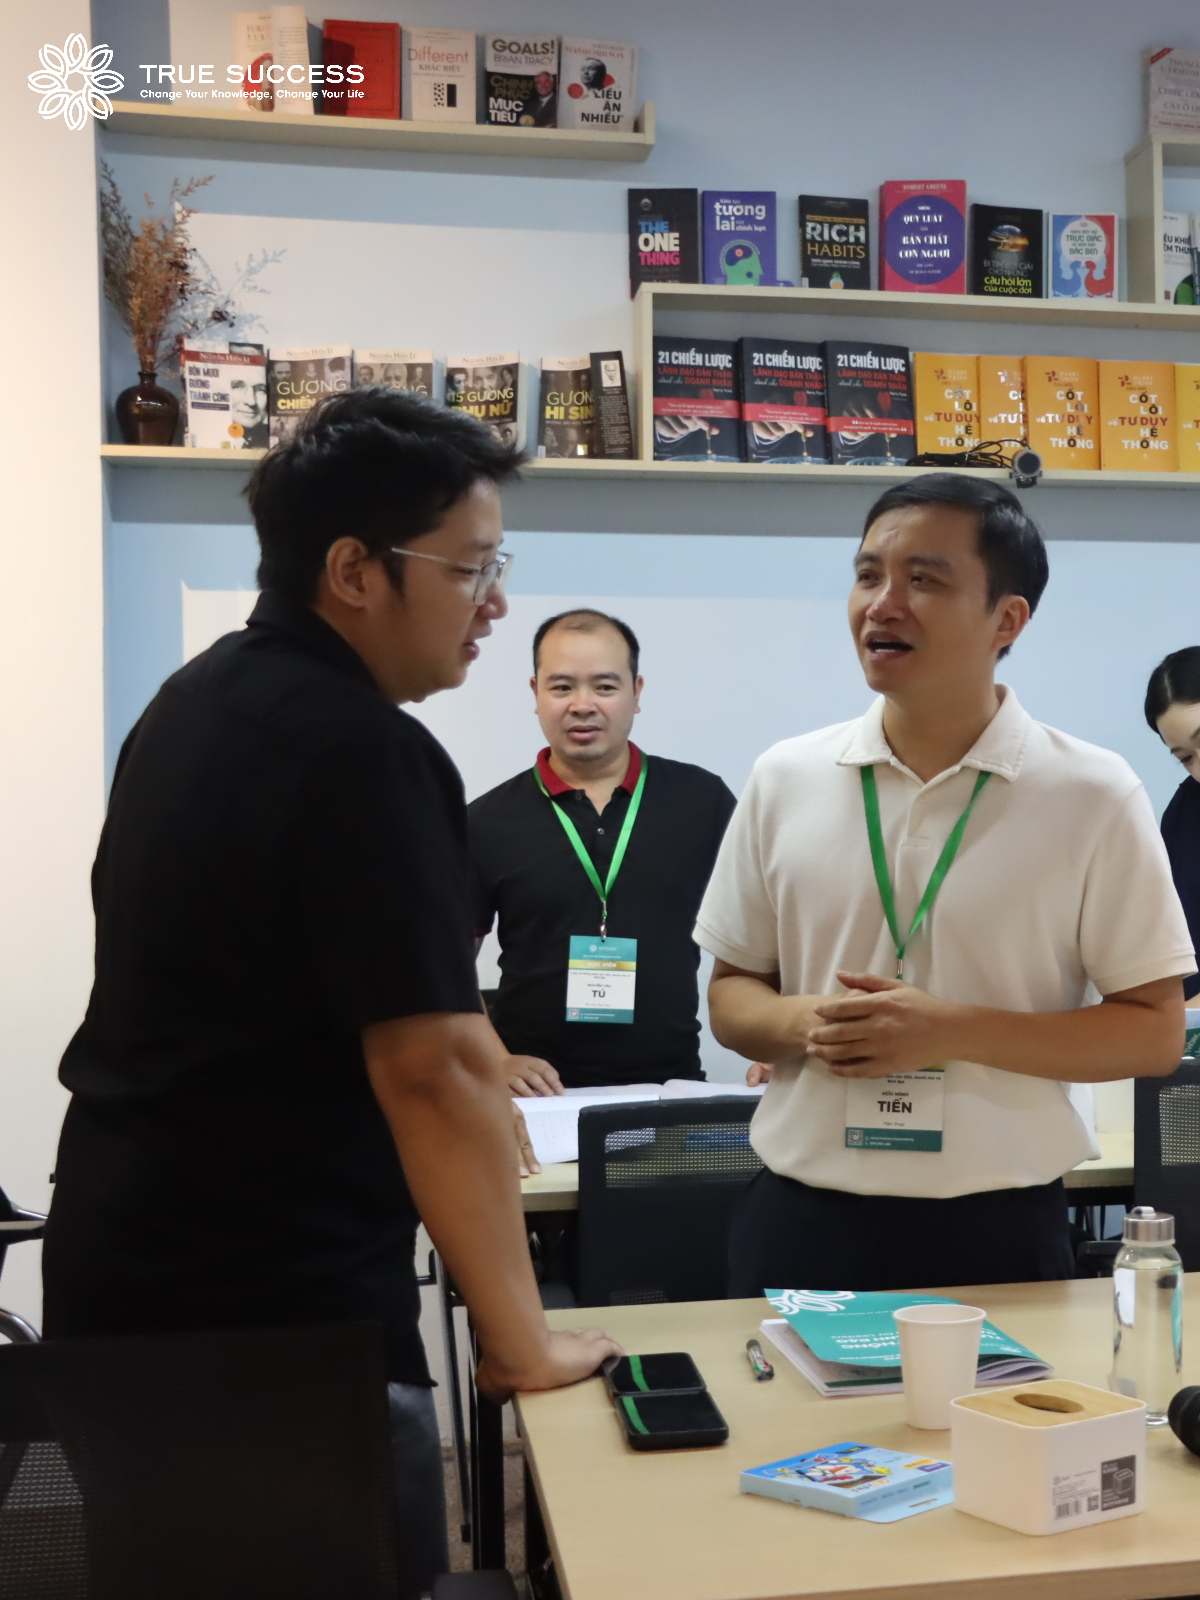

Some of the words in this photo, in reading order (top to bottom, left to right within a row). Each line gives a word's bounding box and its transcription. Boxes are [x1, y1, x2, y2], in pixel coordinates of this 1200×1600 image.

[492, 39, 555, 55] GOALS!
[408, 46, 469, 63] Different
[494, 54, 522, 65] BRIAN
[524, 56, 554, 65] TRACY
[714, 202, 766, 220] tương
[638, 220, 670, 233] THE
[715, 215, 735, 231] lai
[806, 222, 866, 244] RICH
[638, 232, 680, 252] ONE
[807, 242, 866, 259] HABITS
[899, 249, 918, 259] CON
[658, 351, 669, 364] 21
[671, 347, 703, 366] CHIẾN
[705, 353, 732, 370] LƯỢC
[753, 353, 764, 366] 21
[765, 350, 795, 369] CHIẾN
[797, 355, 823, 372] LƯỢC
[837, 354, 848, 367] 21
[850, 351, 879, 369] CHIẾN
[881, 357, 906, 374] LƯỢC
[276, 378, 347, 396] GƯƠNG
[944, 386, 972, 400] CỐT
[1056, 387, 1084, 401] CỐT
[278, 394, 316, 410] CHIẾN
[451, 391, 463, 403] 15
[467, 387, 514, 402] GƯƠNG
[1129, 391, 1158, 404] CỐT
[489, 400, 513, 417] NỮ
[954, 399, 977, 411] LÕI
[1067, 401, 1088, 413] LÕI
[1140, 404, 1162, 415] LÕI
[545, 406, 564, 419] HI
[935, 412, 953, 422] TƯ
[955, 413, 980, 424] DUY
[998, 413, 1019, 424] TƯ
[1046, 413, 1065, 423] TƯ
[1119, 416, 1138, 426] TƯ
[1140, 417, 1168, 426] DUY
[955, 423, 973, 436] HỆ
[1067, 424, 1084, 437] HỆ
[1140, 426, 1158, 439] HỆ
[1050, 435, 1094, 449] THỐNG
[1122, 437, 1169, 450] THỐNG
[591, 988, 606, 998] TÚ
[877, 1098, 912, 1114] TIẾN
